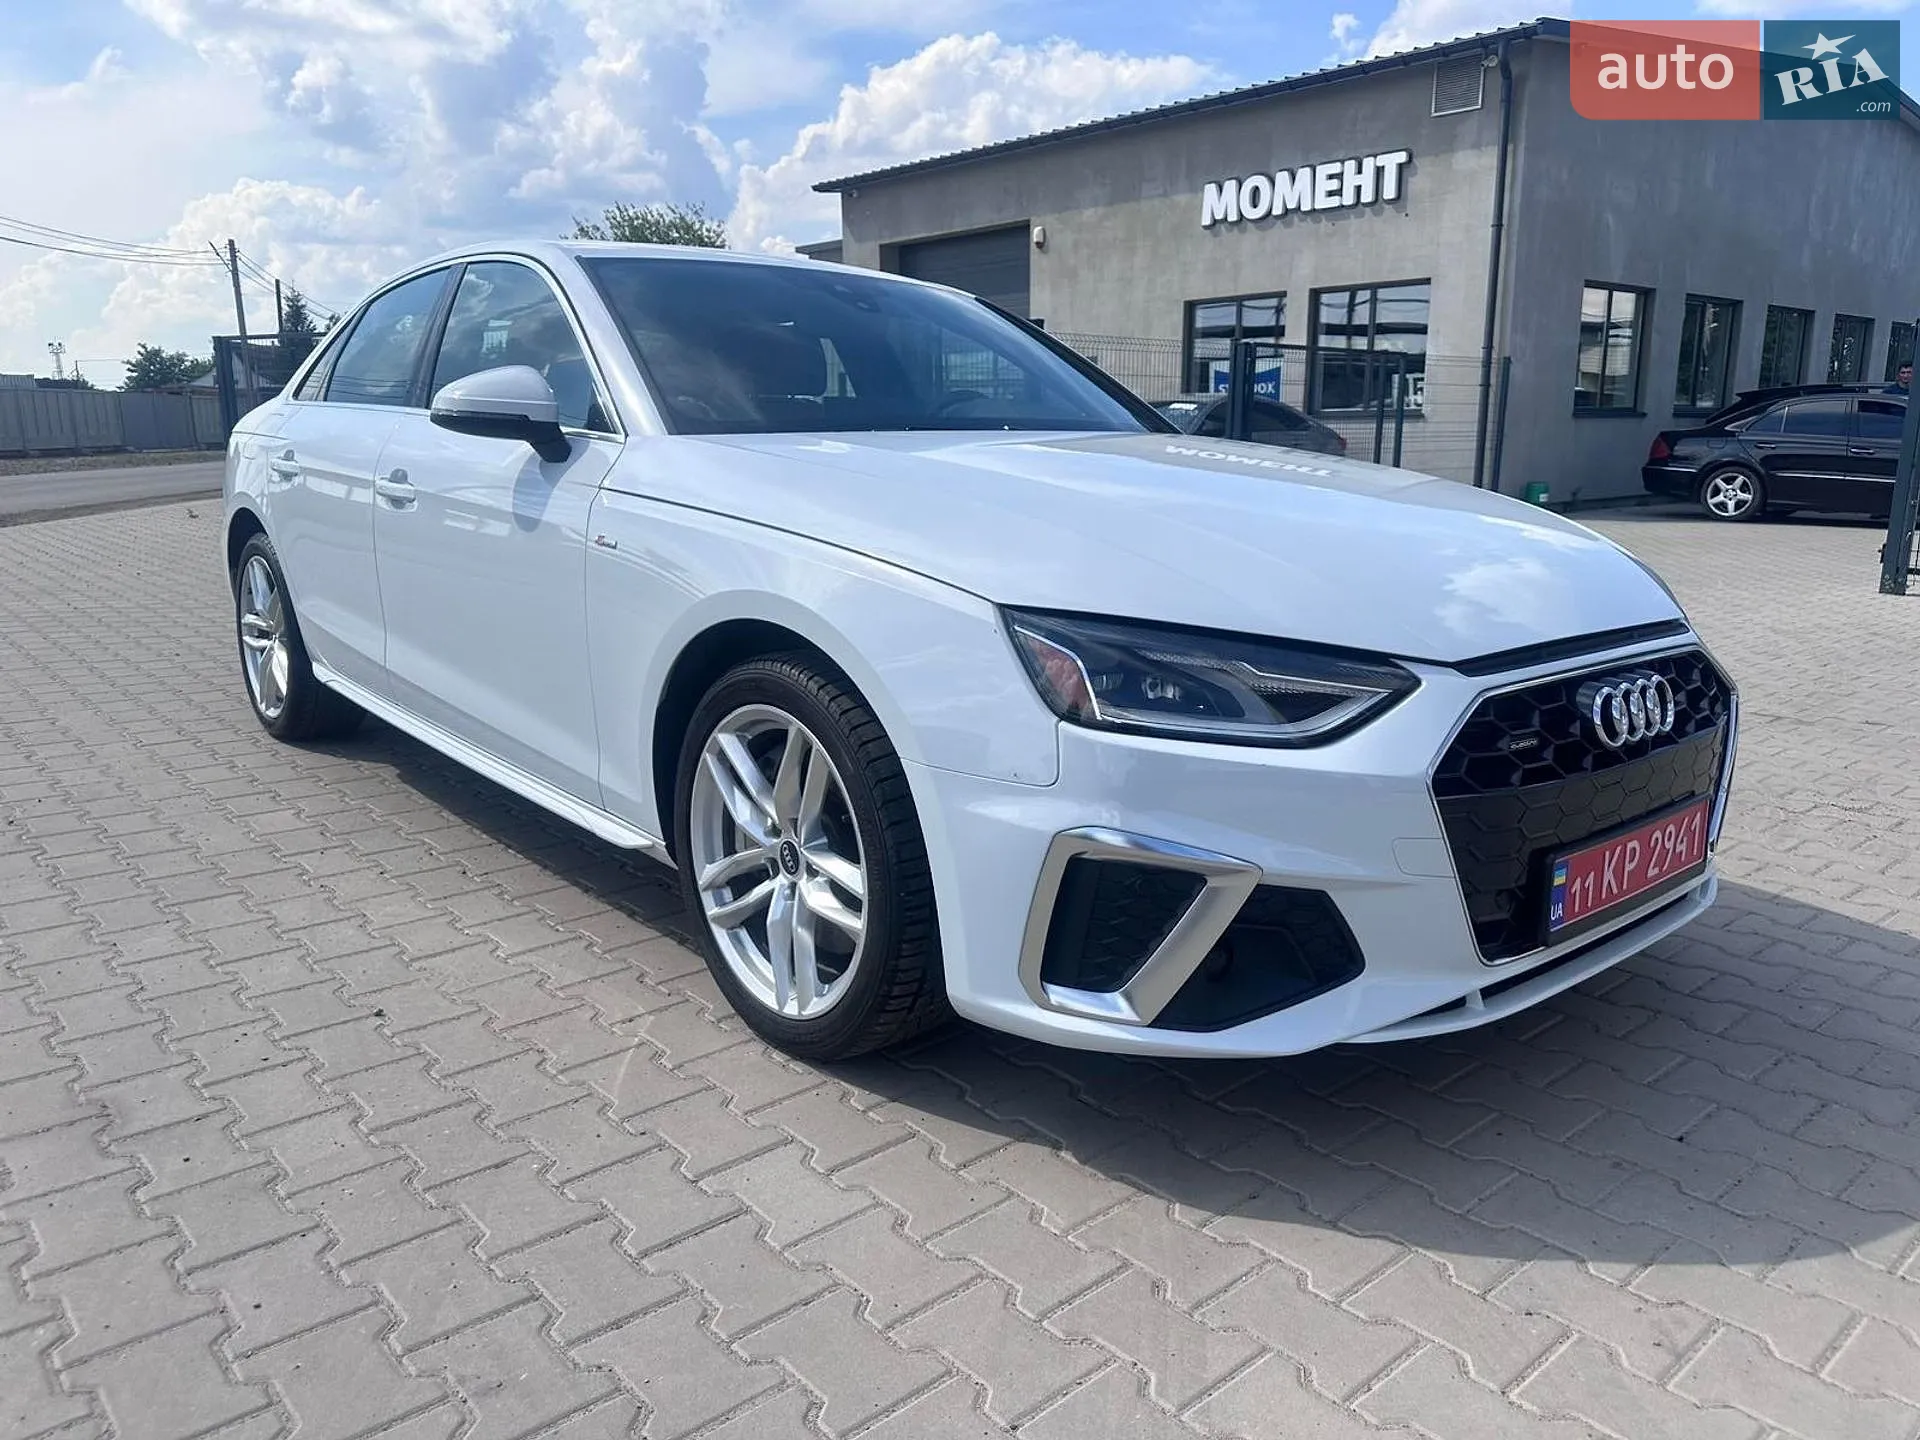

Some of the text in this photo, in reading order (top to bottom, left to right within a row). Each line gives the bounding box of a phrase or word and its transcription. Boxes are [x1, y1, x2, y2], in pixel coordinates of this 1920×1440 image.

[1200, 149, 1411, 228] МОМЕНТ
[1570, 811, 1701, 913] 11 KP 2941
[1550, 902, 1564, 921] UA
